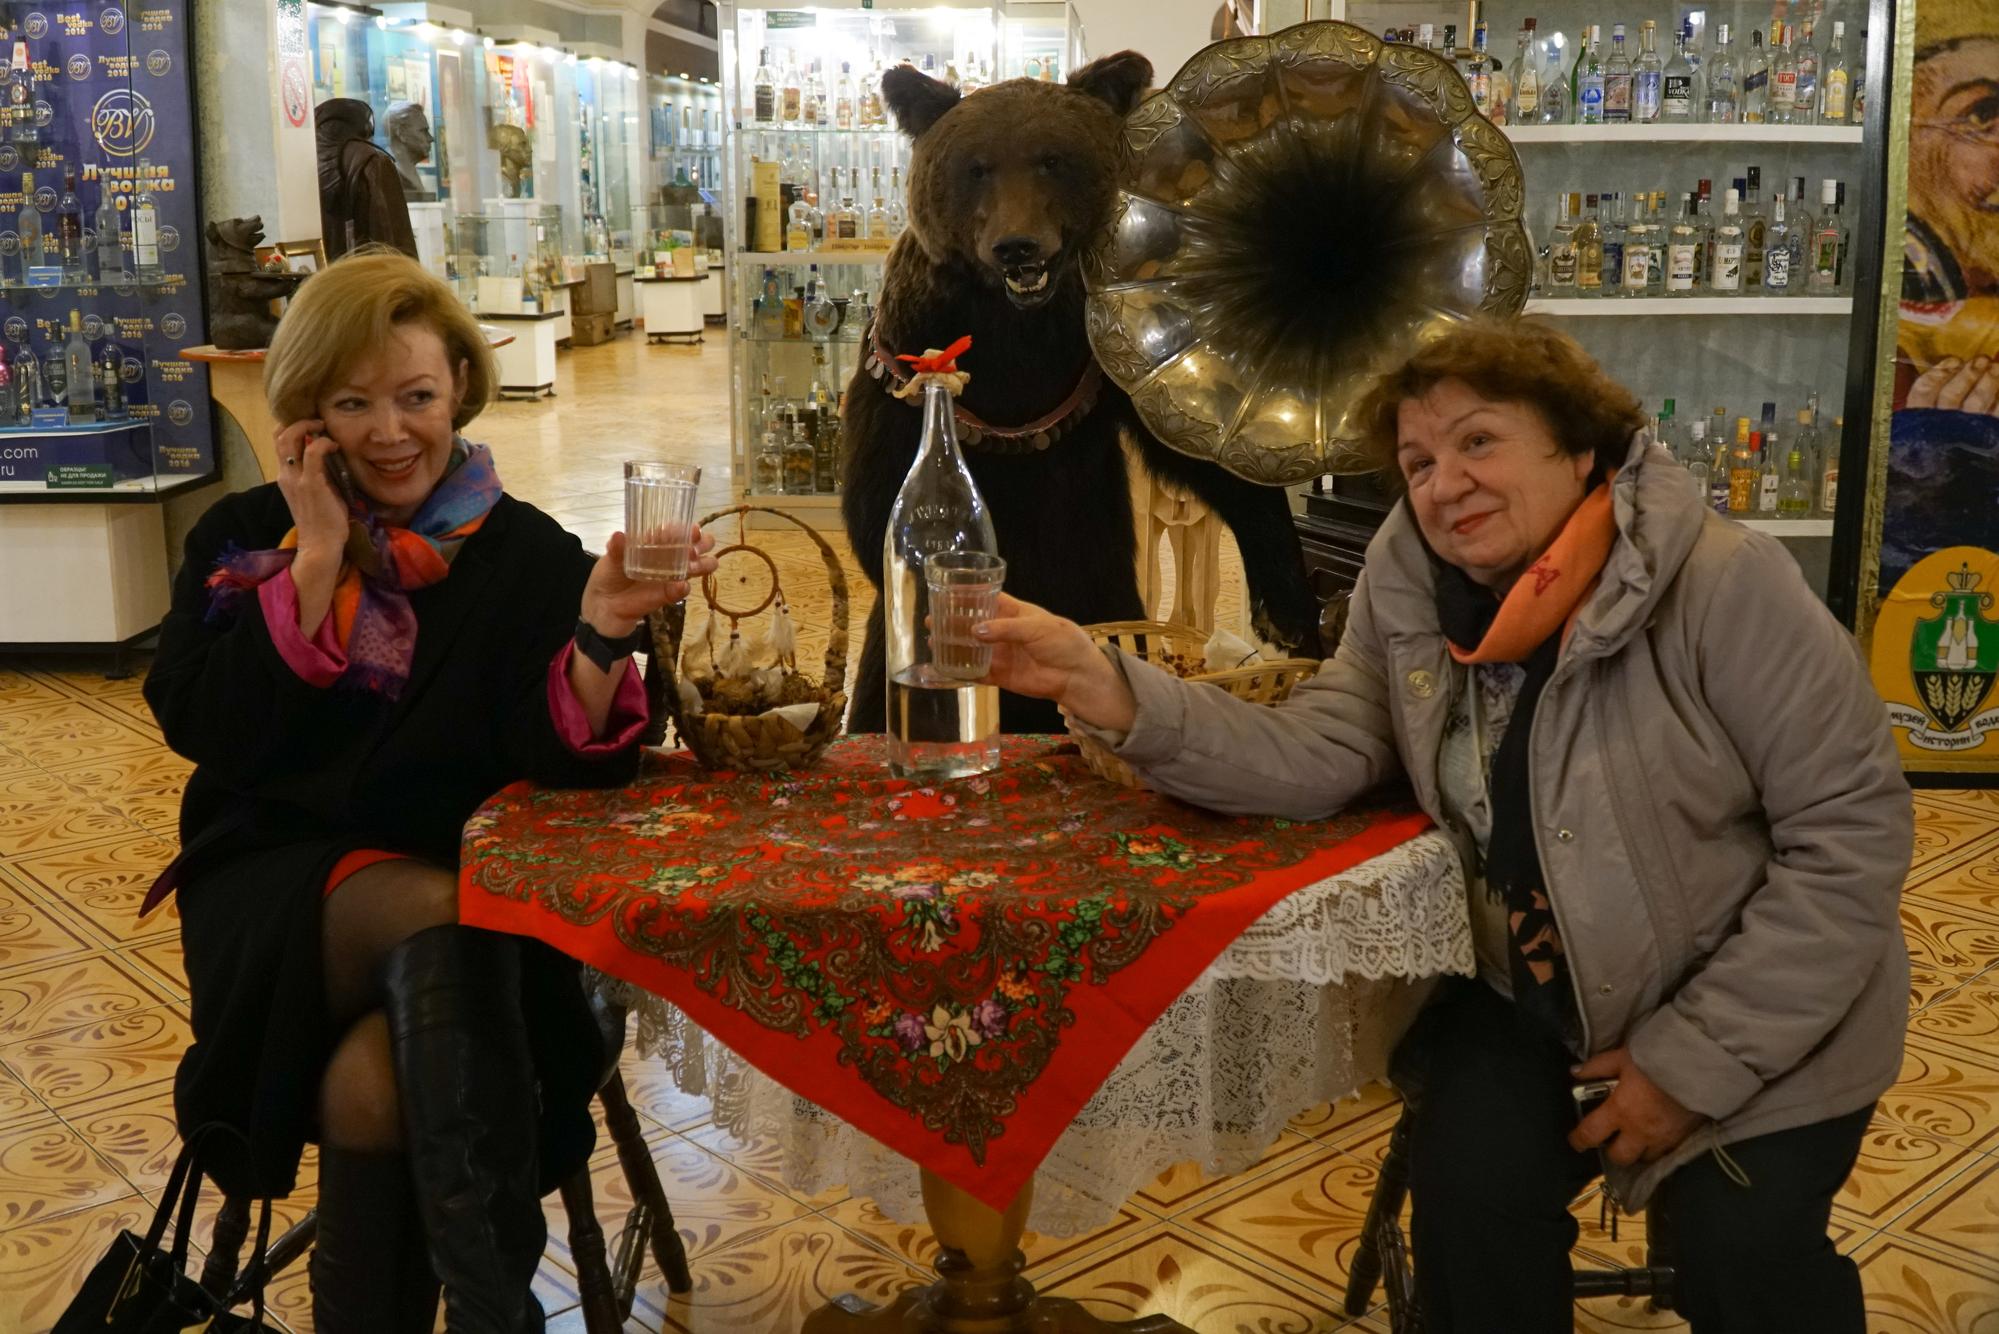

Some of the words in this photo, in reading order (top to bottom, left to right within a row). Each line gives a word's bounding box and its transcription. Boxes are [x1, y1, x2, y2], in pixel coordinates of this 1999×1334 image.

[142, 23, 163, 31] 2016
[107, 69, 128, 77] 2016
[77, 288, 98, 296] 2016
